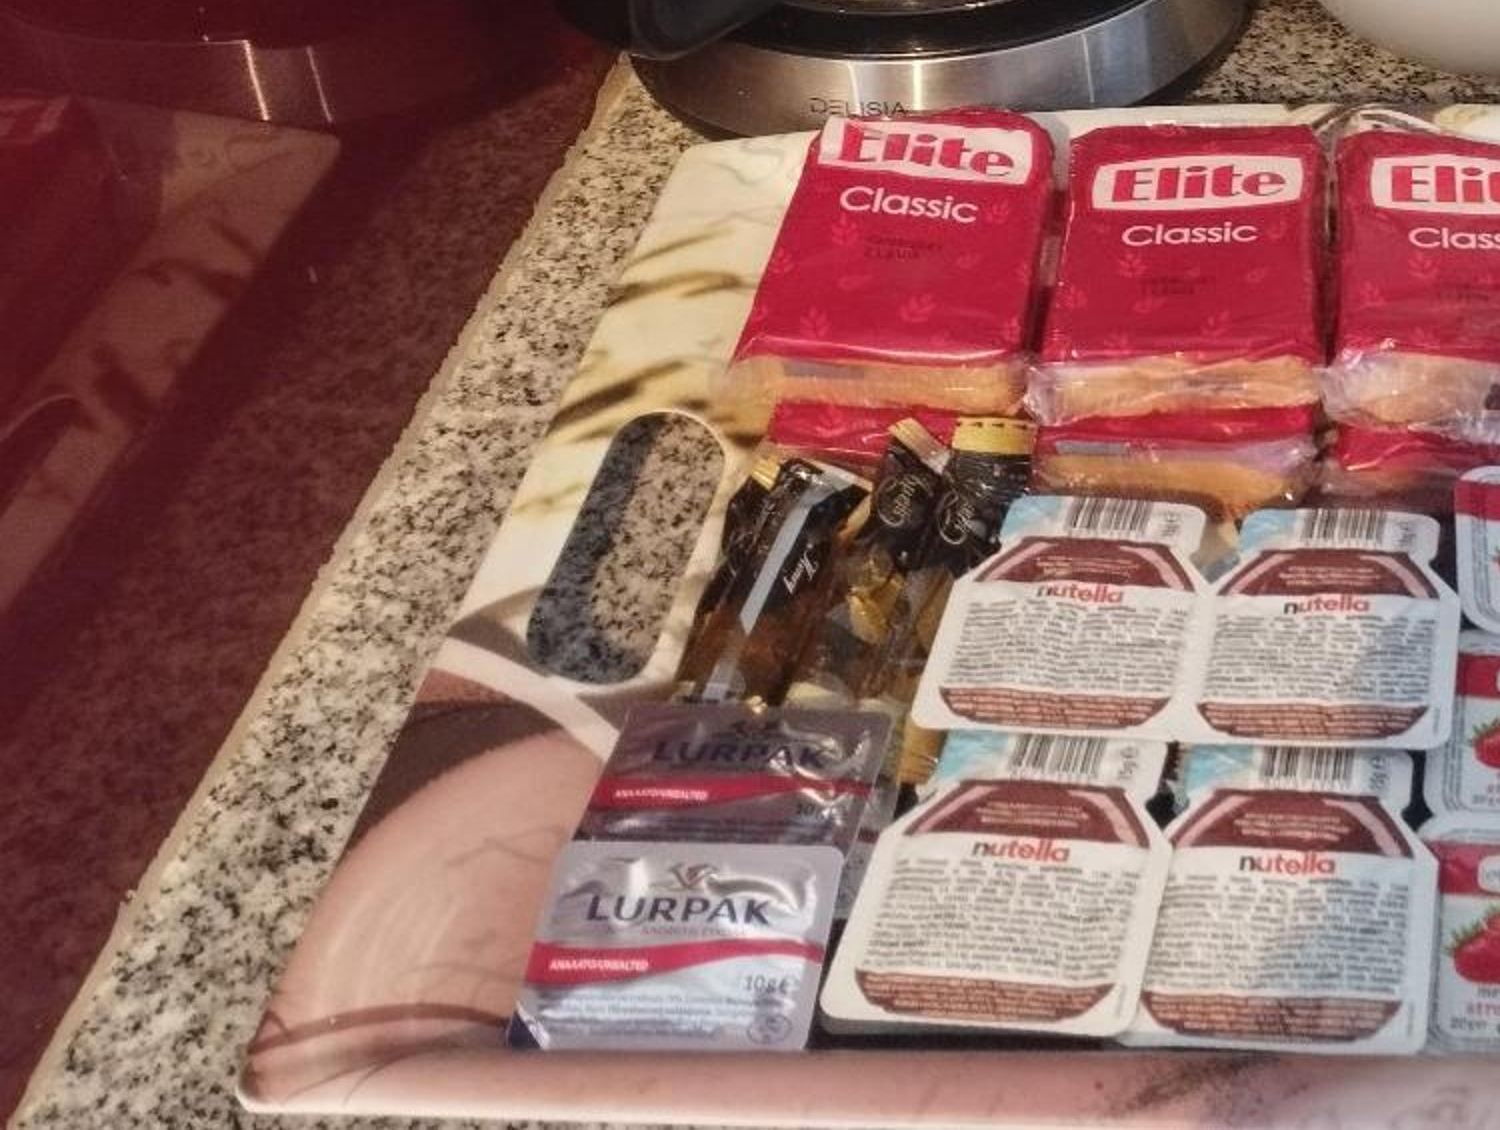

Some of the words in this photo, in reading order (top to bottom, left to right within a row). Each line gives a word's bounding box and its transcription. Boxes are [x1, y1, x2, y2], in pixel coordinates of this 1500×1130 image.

[838, 122, 1015, 177] Elite
[1111, 164, 1286, 203] Elite
[839, 185, 979, 223] Classic
[1121, 221, 1259, 247] Classic
[1037, 582, 1123, 604] nutella
[1284, 596, 1370, 615] nutella
[653, 741, 826, 768] LURPAK
[971, 837, 1070, 864] nutella
[1239, 853, 1337, 876] nutella
[586, 894, 771, 924] LURPAK
